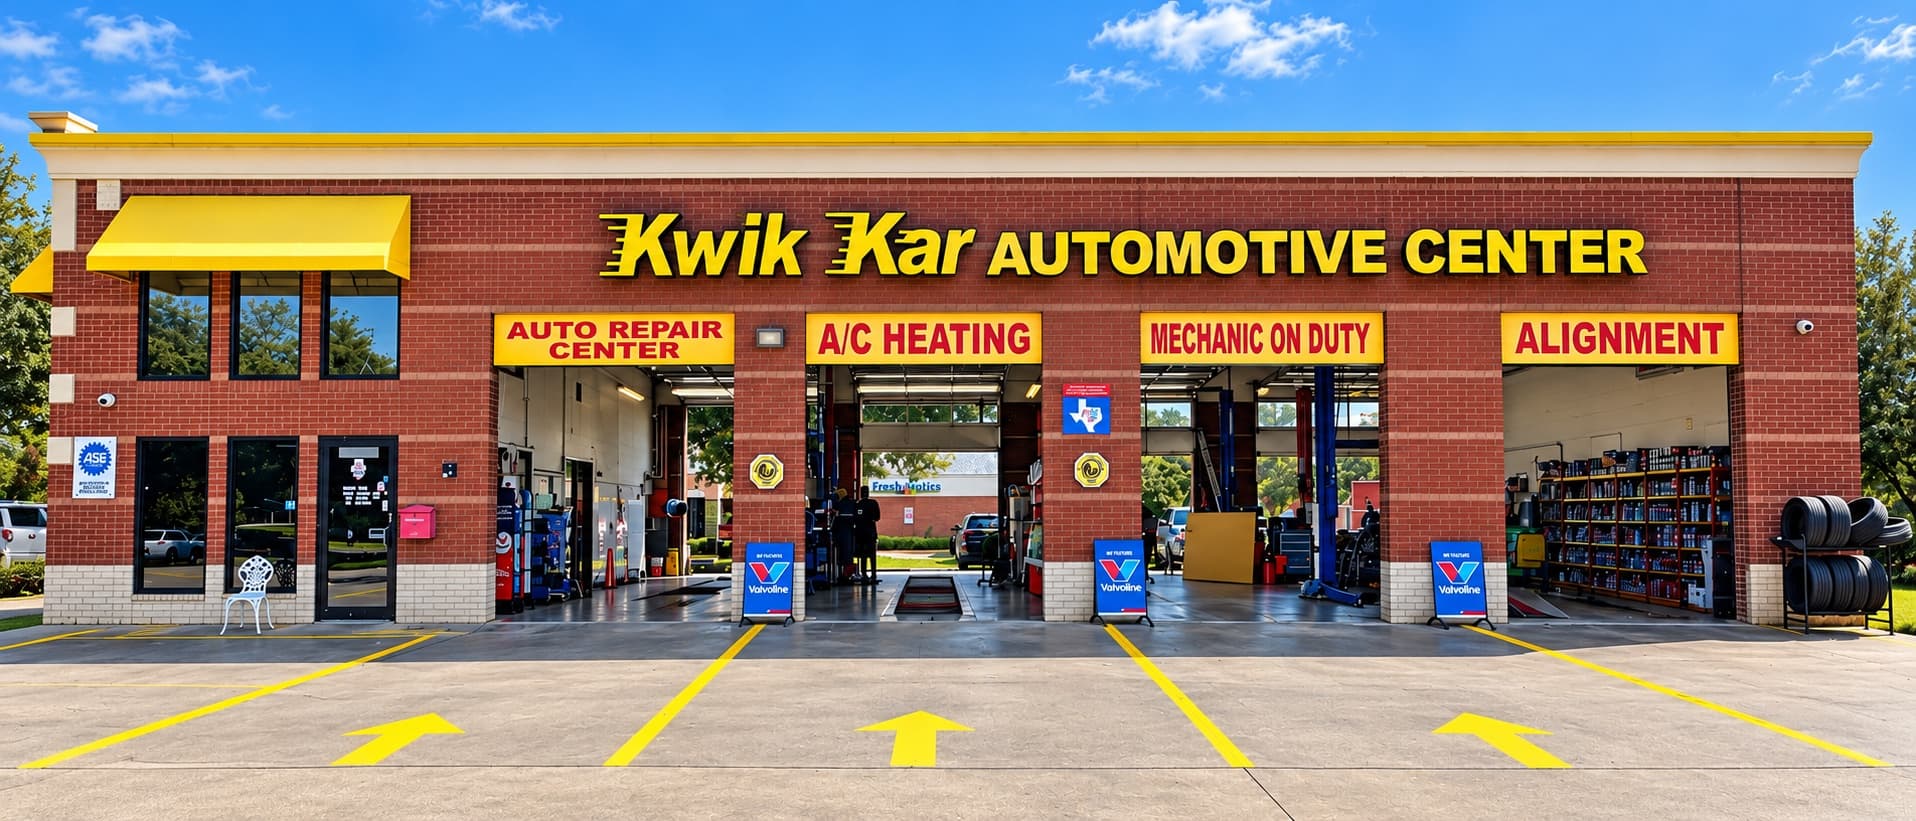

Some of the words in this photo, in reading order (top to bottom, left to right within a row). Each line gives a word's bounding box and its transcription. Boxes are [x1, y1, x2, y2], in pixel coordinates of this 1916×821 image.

[598, 211, 810, 278] Kwik
[823, 210, 978, 277] Kar
[985, 229, 1388, 276] AUTOMOTIVE
[1404, 228, 1649, 276] CENTER
[506, 321, 598, 340] AUTO
[609, 320, 723, 339] REPAIR
[818, 322, 872, 355] A/C
[883, 322, 1031, 355] HEATING
[1151, 322, 1264, 354] MECHANIC
[1270, 322, 1301, 354] ON
[1309, 322, 1370, 354] DUTY
[1515, 321, 1725, 355] ALIGNMENT
[549, 341, 680, 360] CENTER
[83, 452, 107, 464] ASE
[748, 584, 789, 594] Valvoline
[1101, 583, 1143, 592] Valvoline
[1438, 585, 1480, 594] Valvoline
